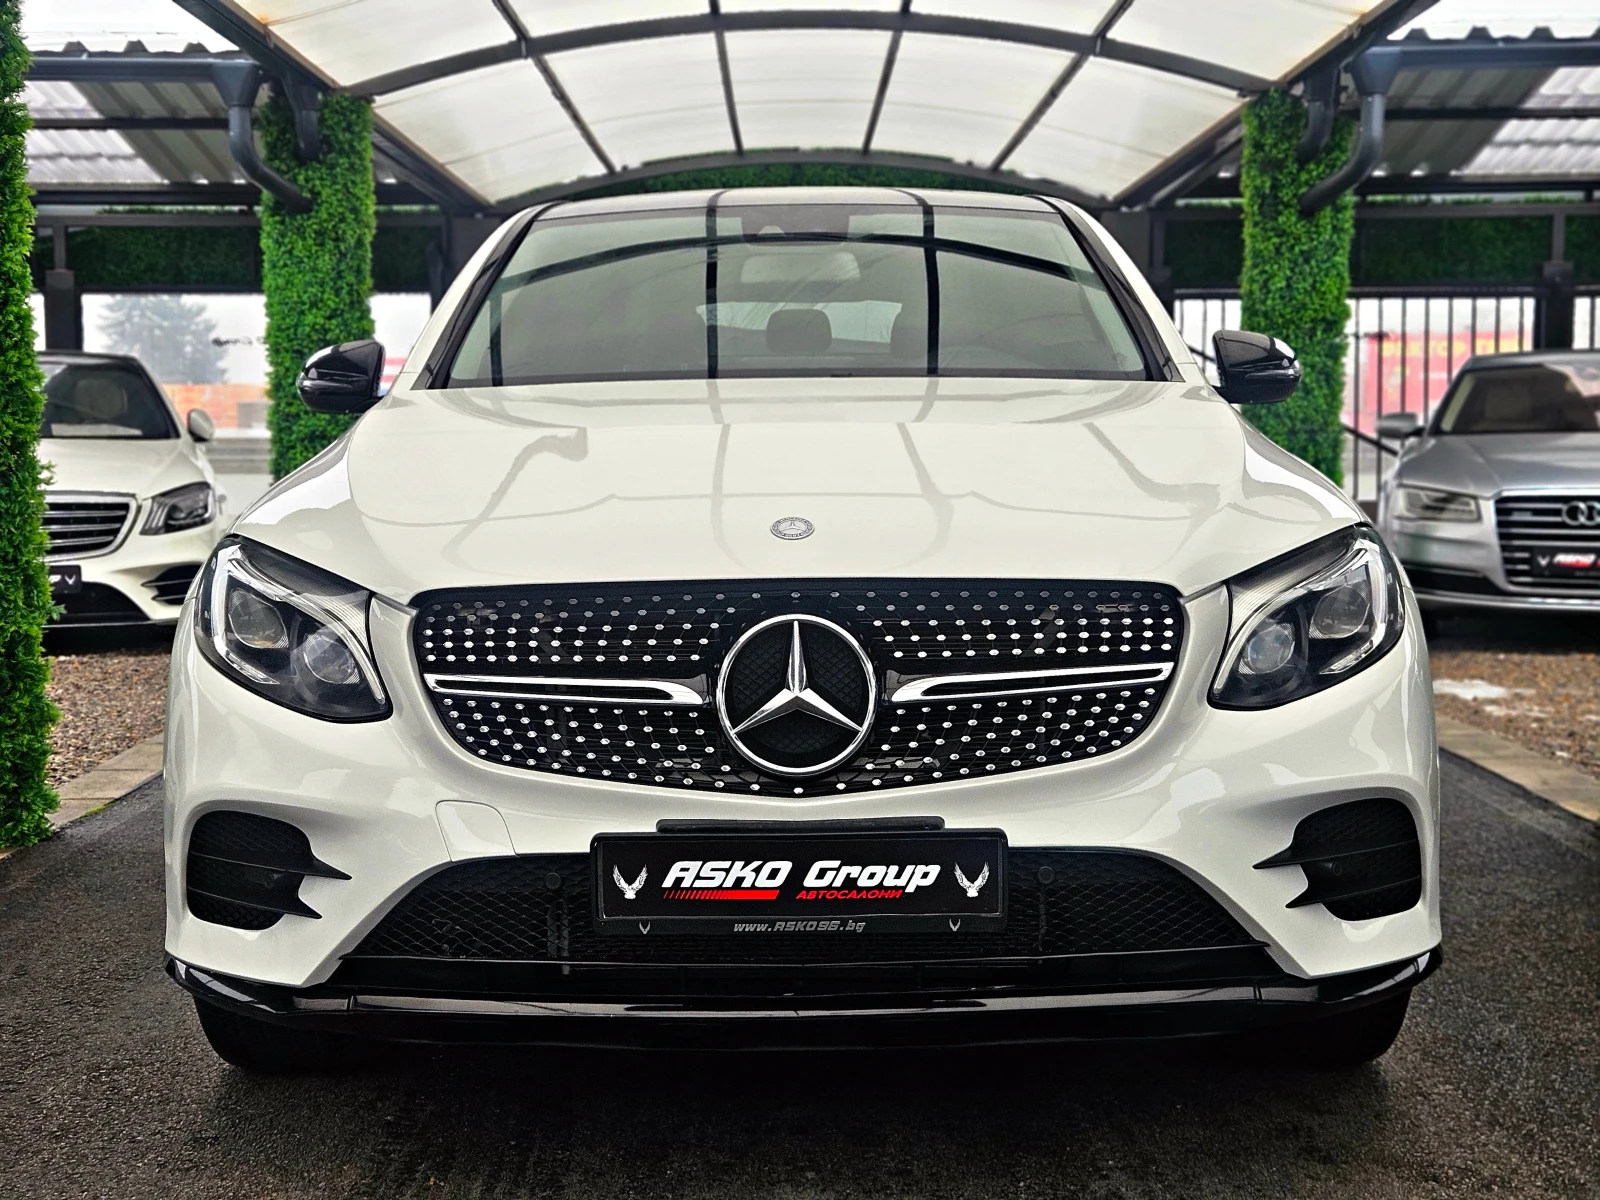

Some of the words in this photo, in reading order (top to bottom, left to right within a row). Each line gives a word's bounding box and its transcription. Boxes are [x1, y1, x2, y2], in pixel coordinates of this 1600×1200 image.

[661, 860, 793, 888] ASKO
[802, 860, 941, 893] Group
[796, 889, 903, 900] АВТОСАЛОНИ
[733, 920, 866, 933] www.ASKO96.bg
